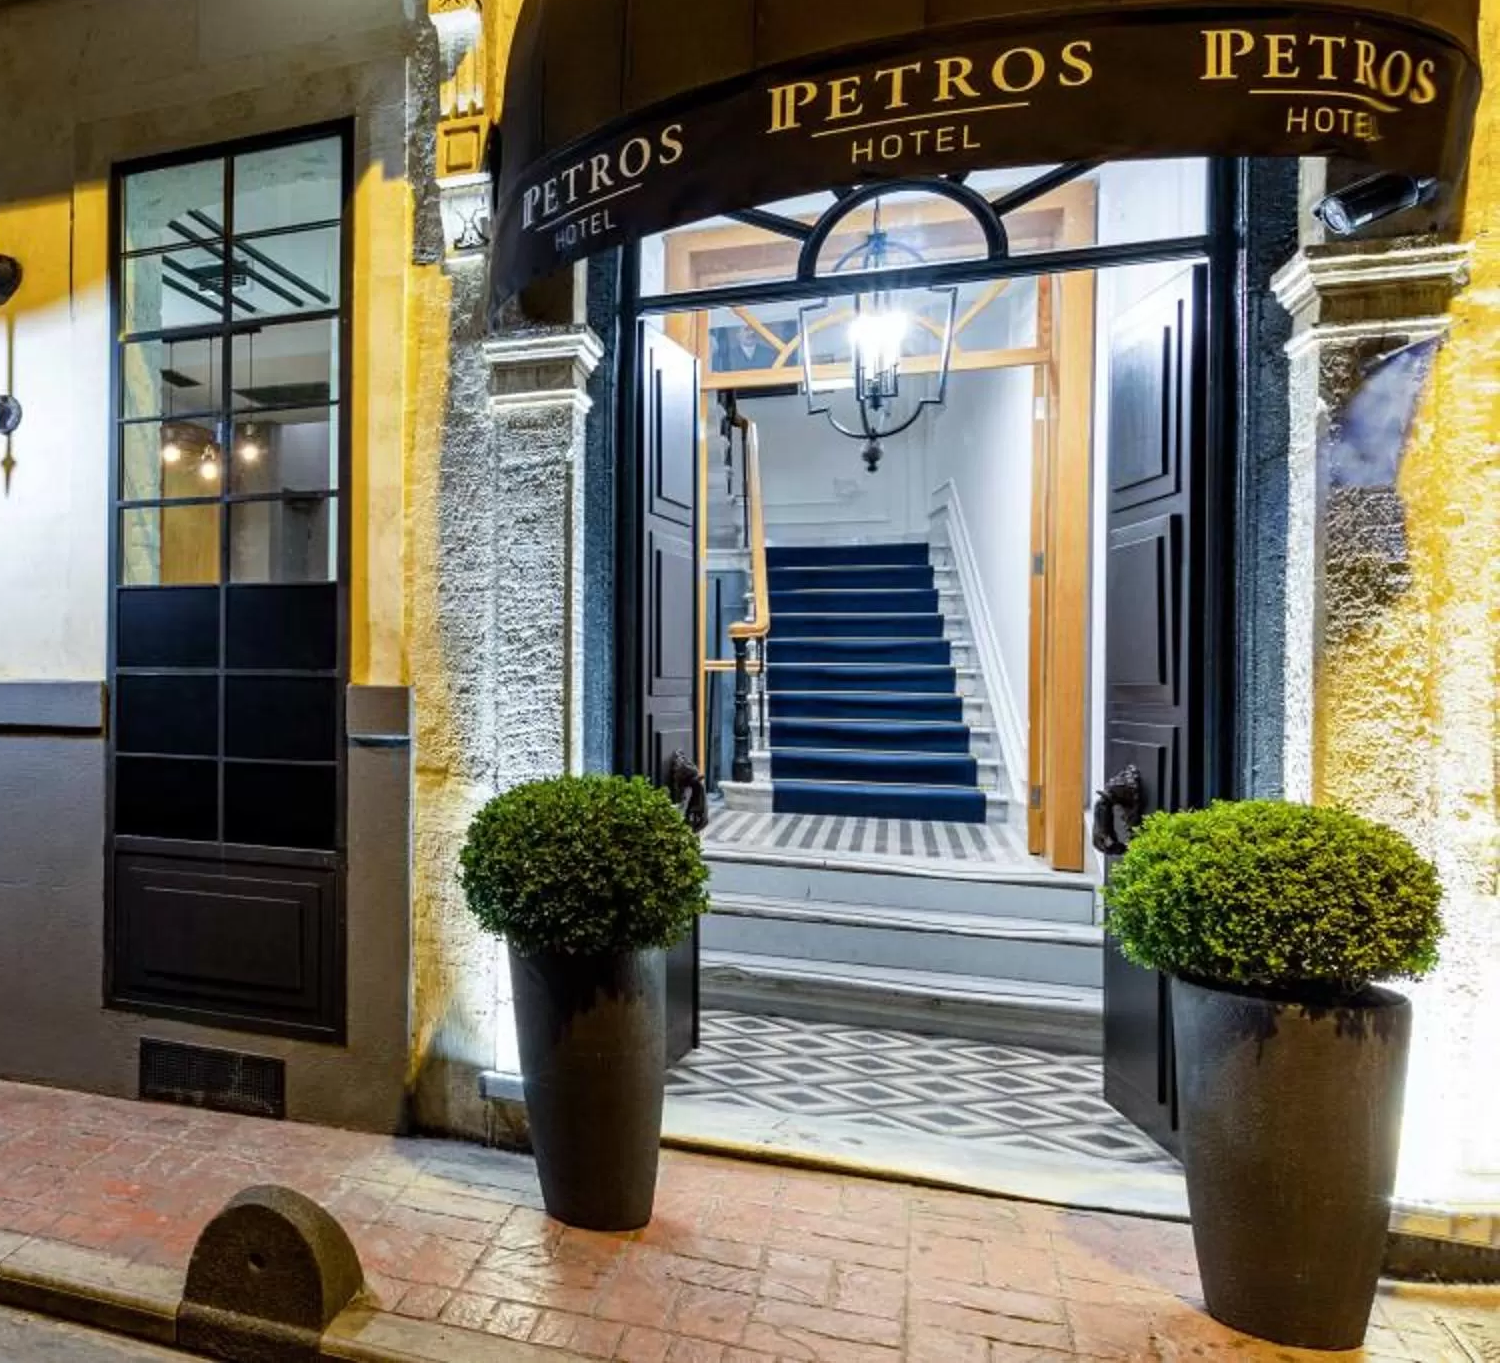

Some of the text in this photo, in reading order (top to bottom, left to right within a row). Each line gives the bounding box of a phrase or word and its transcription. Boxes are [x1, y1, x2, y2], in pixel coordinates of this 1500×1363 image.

[766, 39, 1094, 134] PETROS
[1198, 28, 1438, 104] PETROS
[521, 124, 684, 230] PETROS
[851, 125, 982, 163] HOTEL
[555, 209, 617, 252] HOTEL
